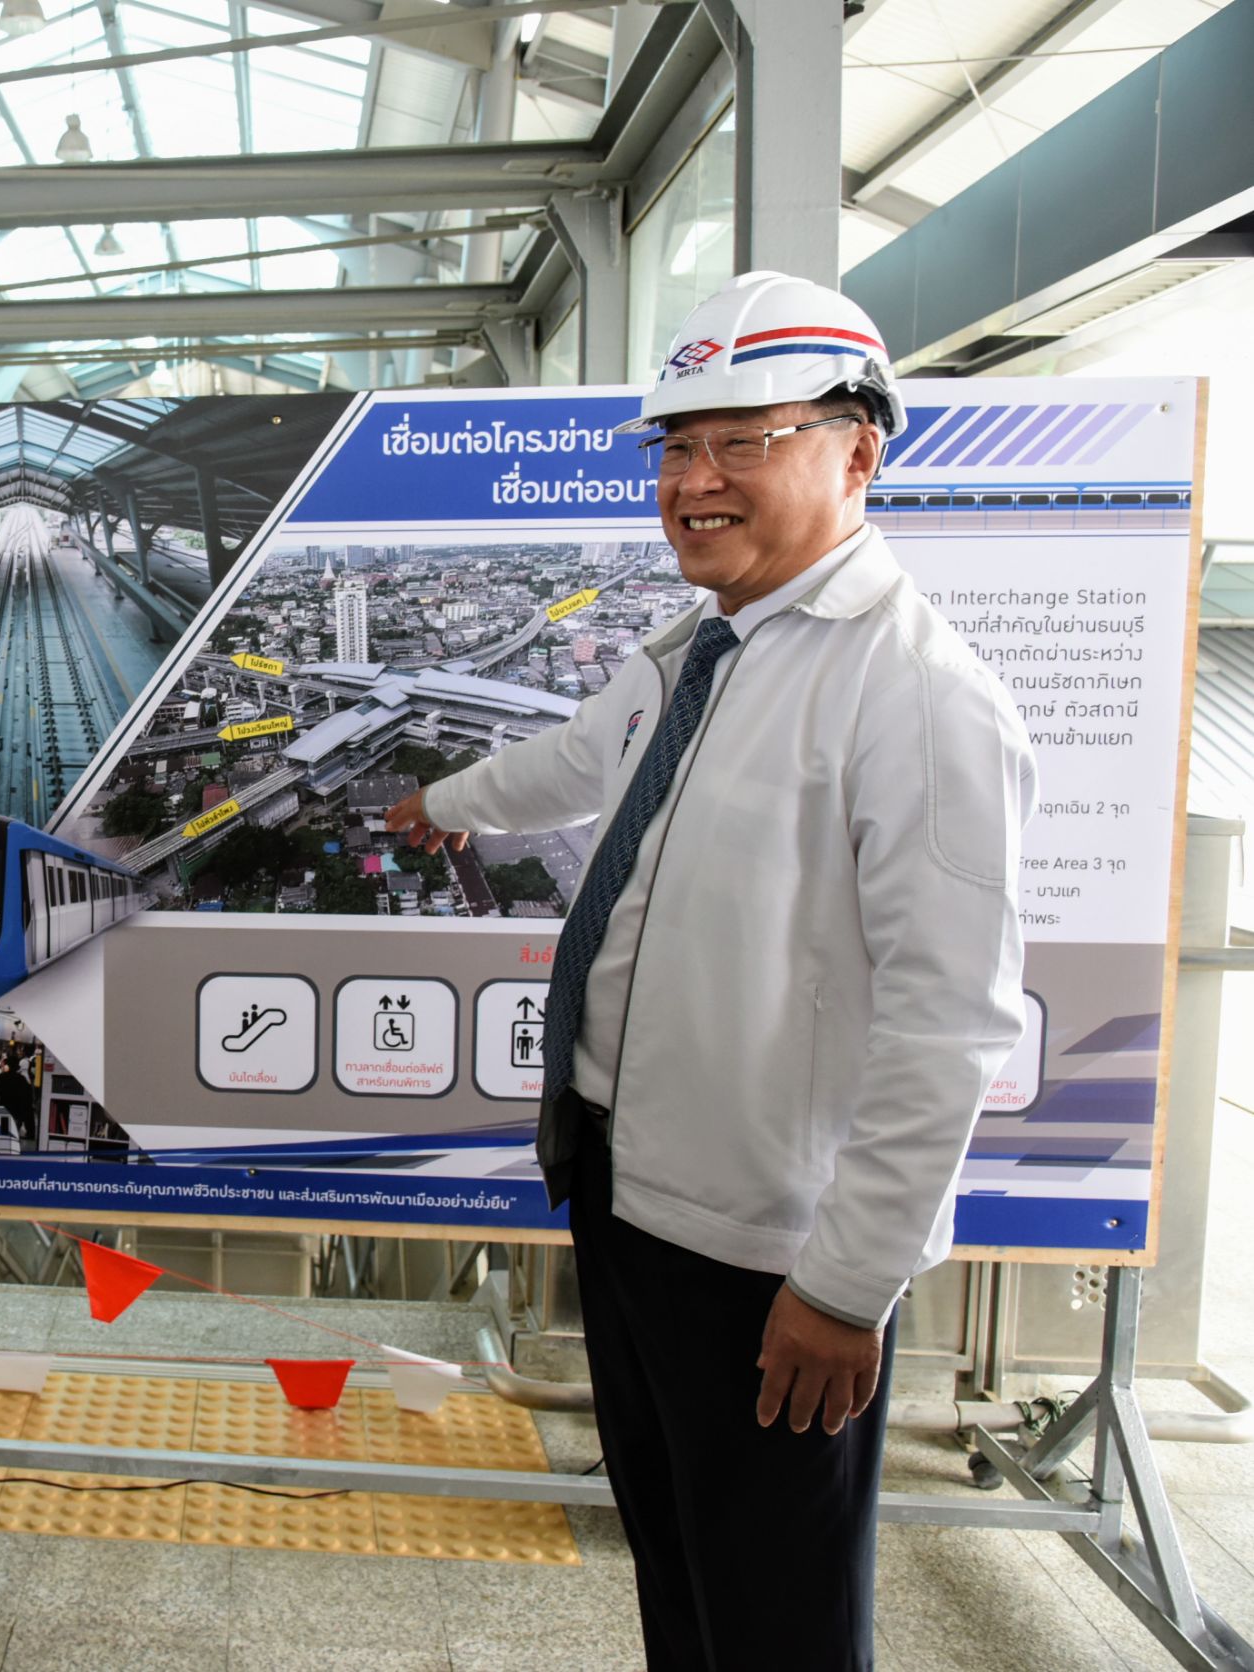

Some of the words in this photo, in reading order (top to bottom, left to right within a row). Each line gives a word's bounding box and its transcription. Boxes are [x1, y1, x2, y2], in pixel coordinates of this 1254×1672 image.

[676, 365, 704, 379] MRTA
[382, 413, 614, 455] เชื่อมต่อโครงข่าย
[492, 461, 658, 504] เชื่อมต่ออนา
[951, 588, 1069, 610] Interchange
[1077, 587, 1146, 605] Station
[1012, 672, 1142, 689] ถนนรัชดาภิเษก
[1065, 699, 1138, 717] ตัวสถานี
[1028, 727, 1133, 745] พานข้ามแยก
[1096, 801, 1105, 815] 2
[1110, 803, 1130, 819] จุด
[1053, 857, 1088, 870] Area
[1093, 857, 1102, 870] 3
[1107, 858, 1126, 874] จุด
[1036, 886, 1081, 897] บางแค
[229, 1069, 278, 1083] บันไดเลื่อน
